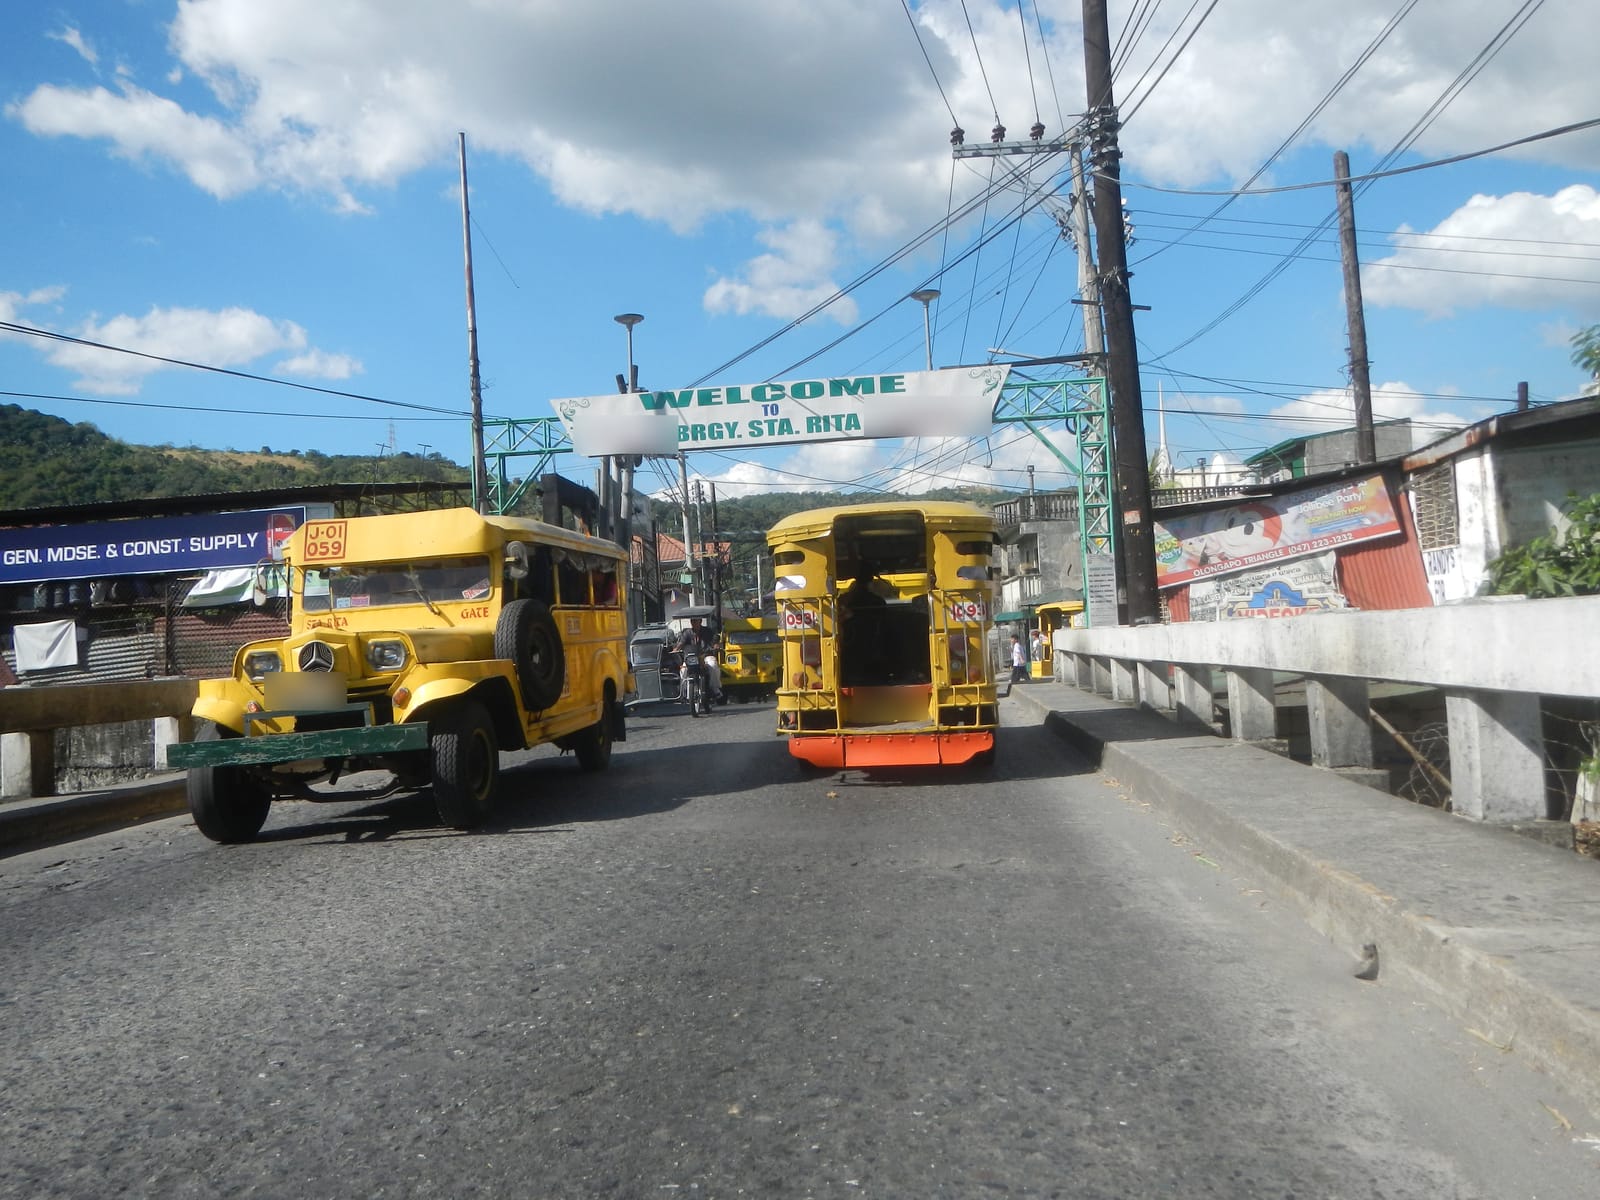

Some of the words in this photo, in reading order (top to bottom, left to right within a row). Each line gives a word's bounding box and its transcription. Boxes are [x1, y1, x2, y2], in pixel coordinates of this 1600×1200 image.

[639, 375, 906, 410] WELCOME
[762, 403, 779, 417] TO
[678, 421, 742, 442] BRGY.
[748, 418, 800, 438] STA.
[806, 413, 861, 434] RITA
[1298, 498, 1335, 513] Jollibee
[1336, 490, 1366, 505] Party!
[3, 549, 42, 565] GEN.
[47, 545, 100, 562] MDSE.
[106, 543, 118, 558] &
[123, 539, 185, 557] CONST.
[190, 532, 259, 552] SUPPLY
[307, 541, 342, 556] 059
[1193, 559, 1242, 577] OLONGAPO
[1244, 549, 1284, 565] TRIANGLE
[1288, 543, 1311, 556] (047)
[1312, 533, 1353, 549] 223-1232
[461, 607, 489, 619] GATE
